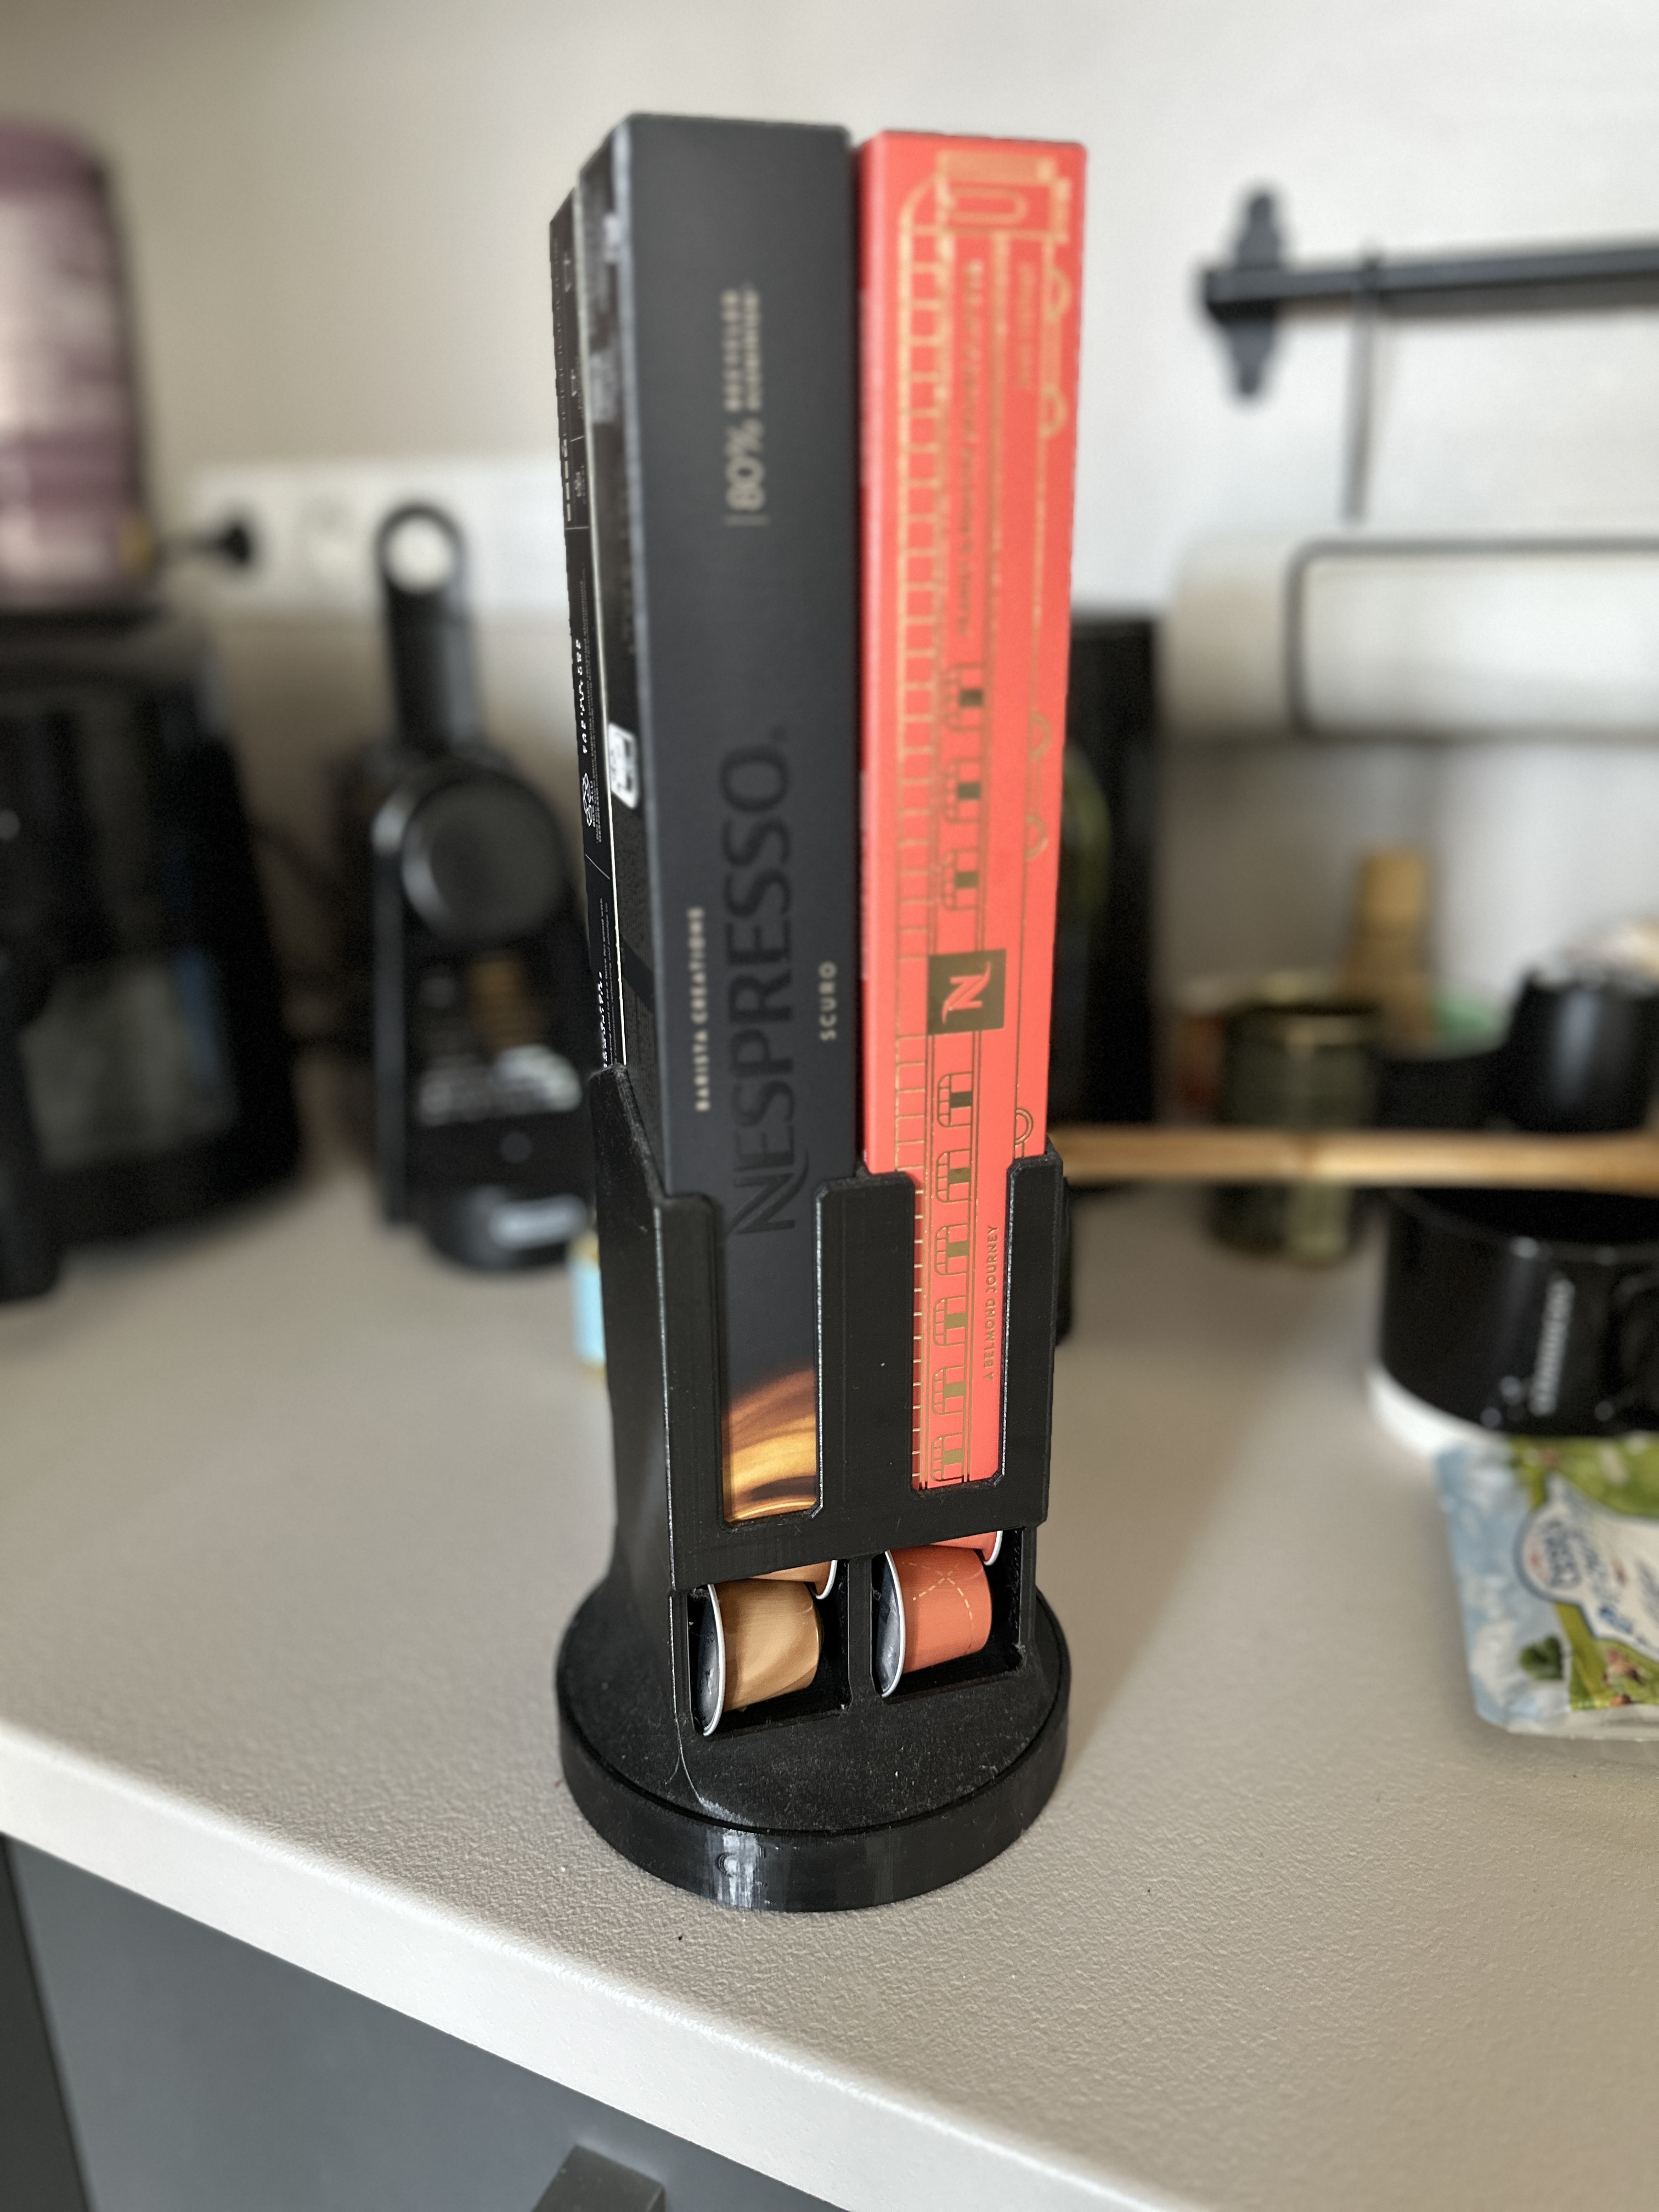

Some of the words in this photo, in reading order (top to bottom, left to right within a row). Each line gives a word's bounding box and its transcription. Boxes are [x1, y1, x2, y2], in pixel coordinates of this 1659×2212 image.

[687, 907, 708, 1024] CREATIONS
[718, 743, 809, 1235] NESPRESSO
[819, 961, 837, 1040] SCURO
[694, 1029, 710, 1111] BARISTA
[986, 1225, 998, 1294] JOURNEY
[984, 1298, 996, 1368] BELMOND
[984, 1372, 994, 1380] A
